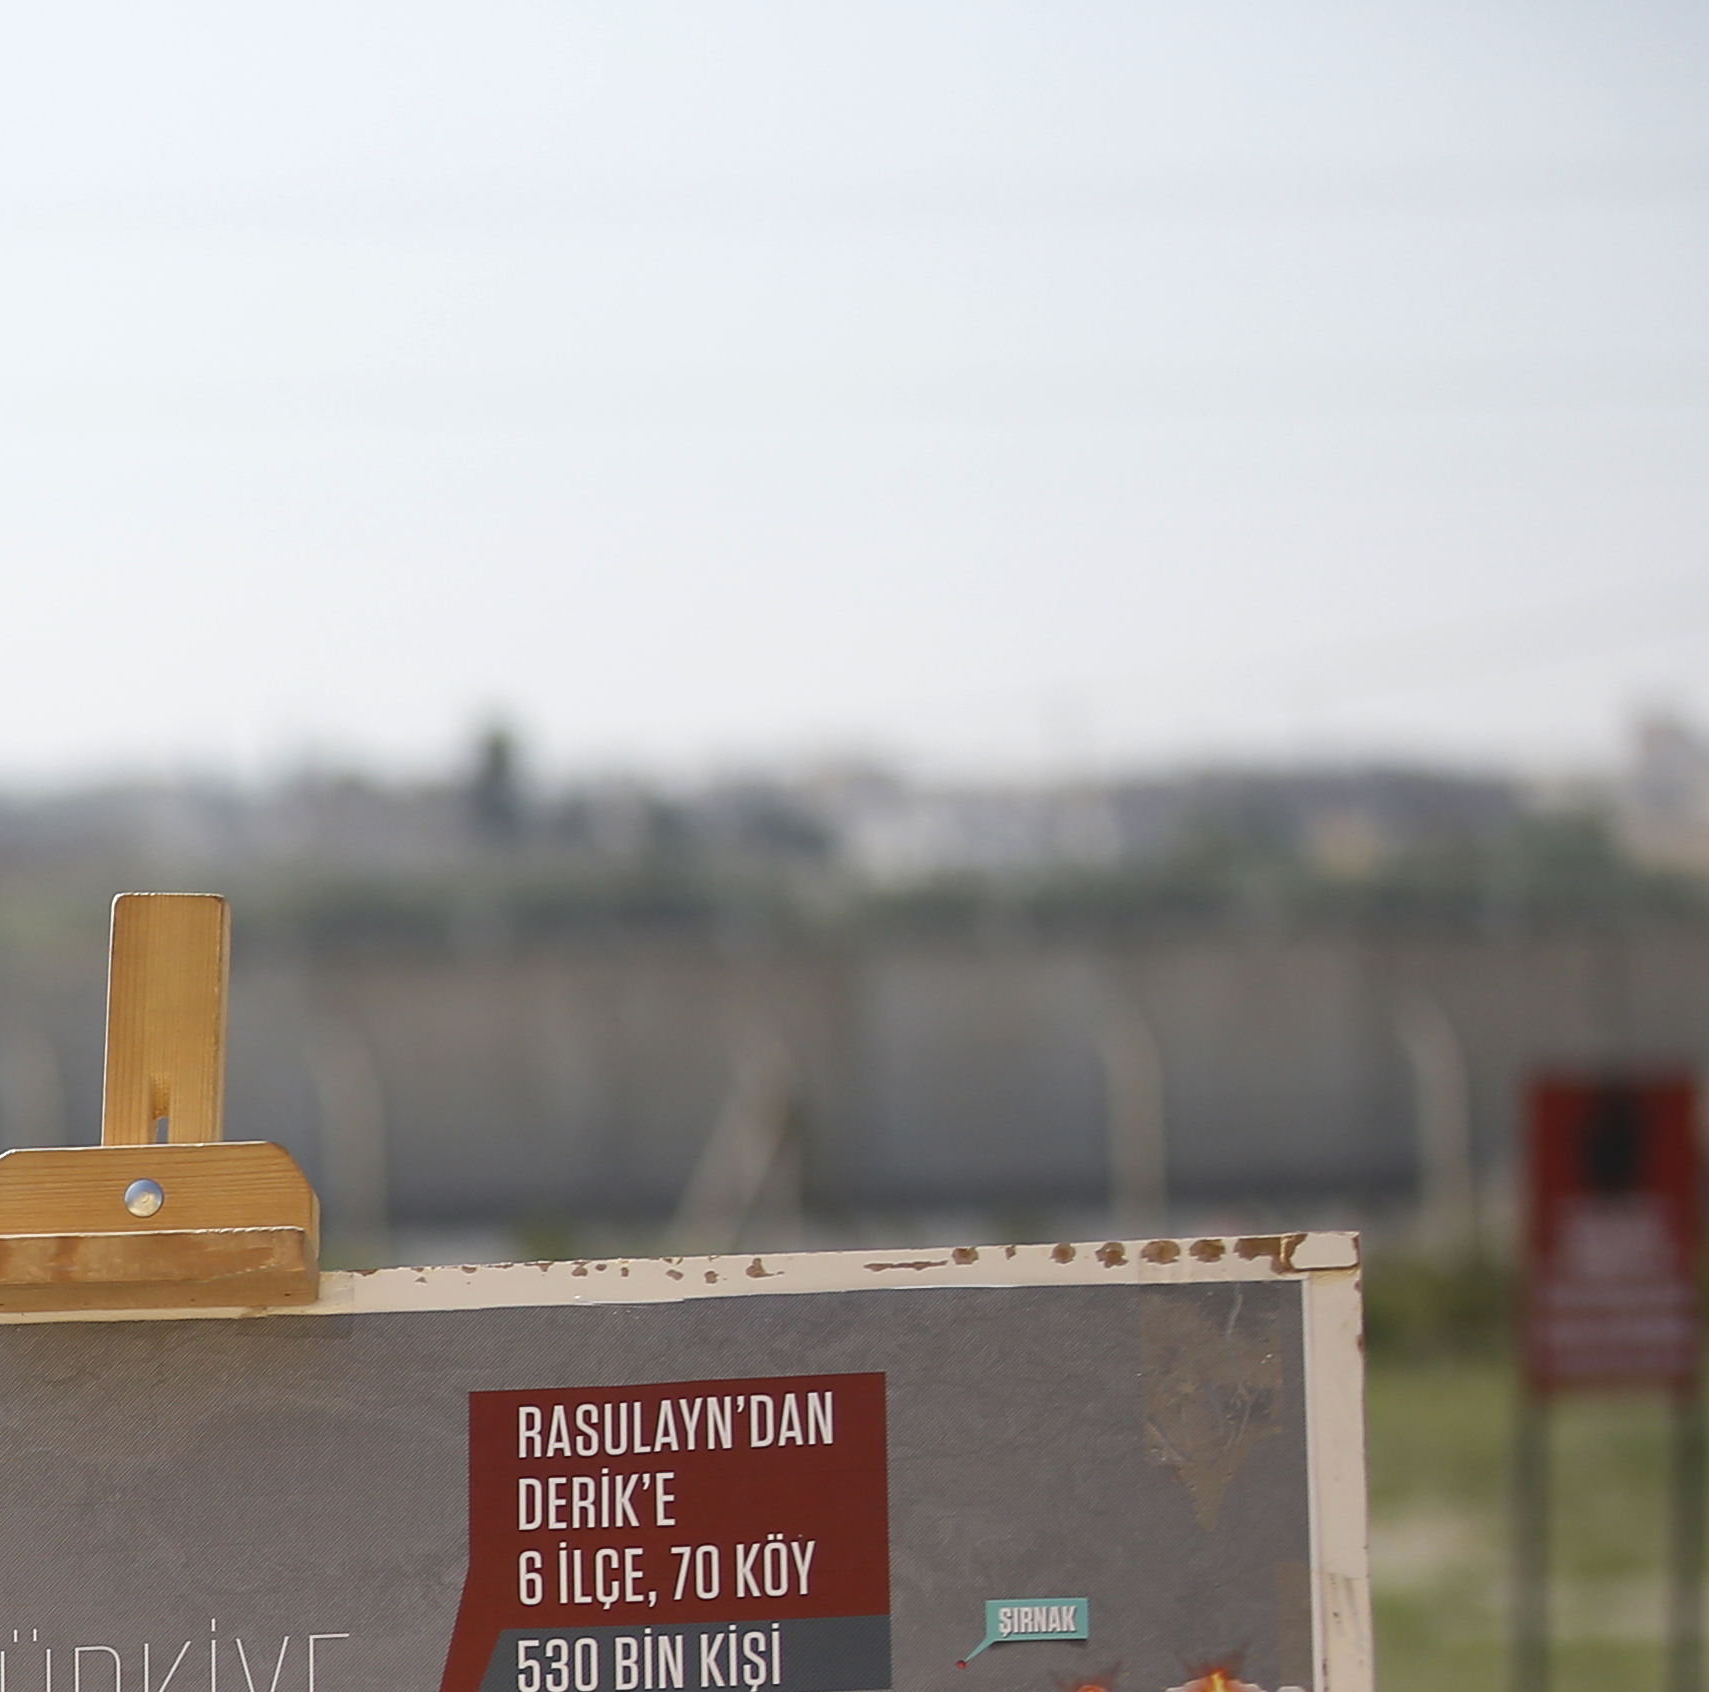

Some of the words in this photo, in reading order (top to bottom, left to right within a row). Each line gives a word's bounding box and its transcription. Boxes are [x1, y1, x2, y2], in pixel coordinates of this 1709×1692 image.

[517, 1391, 834, 1459] RASULAYN'DAN
[517, 1468, 676, 1531] DERİK'E
[517, 1550, 543, 1606] 6
[559, 1541, 657, 1610] İLÇE,
[670, 1544, 720, 1601] 70
[735, 1533, 816, 1598] KÖY
[997, 1605, 1077, 1637] ŞIRNAK
[614, 1627, 684, 1691] BİN
[699, 1622, 781, 1692] KİŞİ
